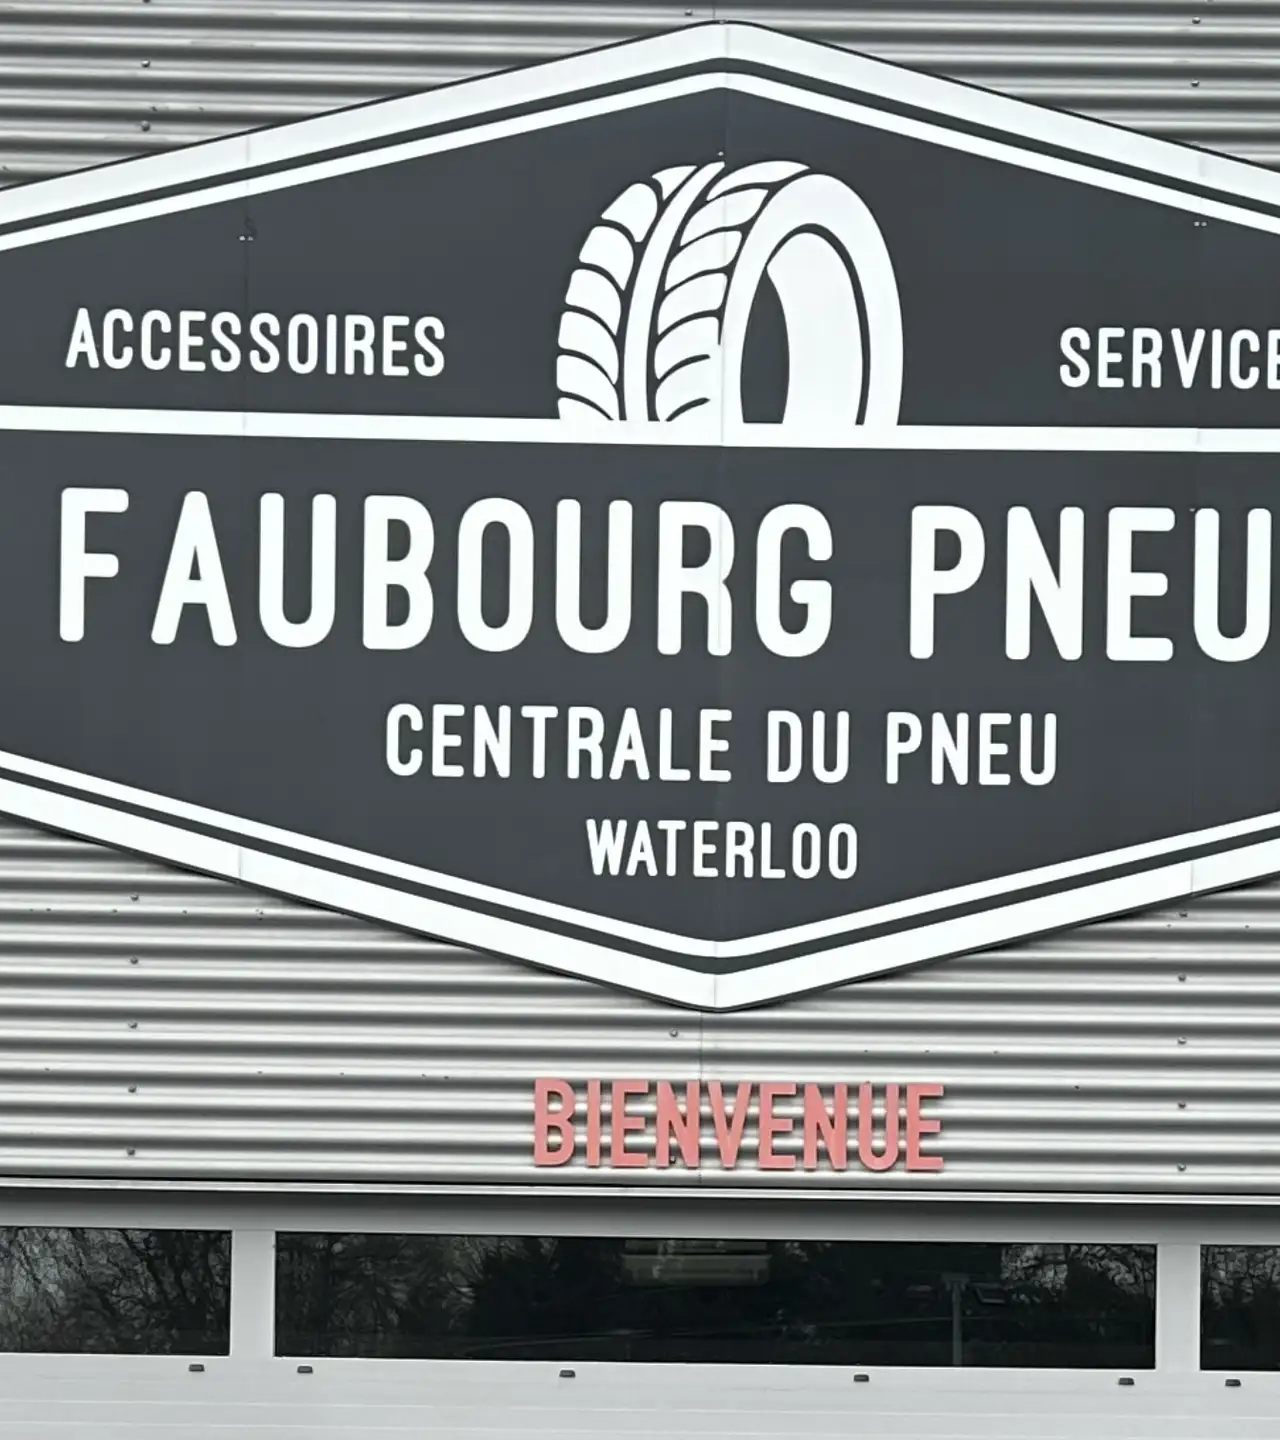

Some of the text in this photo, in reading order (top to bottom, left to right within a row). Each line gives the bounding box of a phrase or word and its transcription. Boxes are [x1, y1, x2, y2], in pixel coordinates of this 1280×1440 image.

[66, 308, 444, 376] ACCESSOIRES
[60, 488, 832, 657] FAUBOURG
[387, 704, 1056, 785] CENTRALE DU PNEU
[586, 819, 857, 879] WATERLOO
[536, 1080, 940, 1167] BIENVENUE
